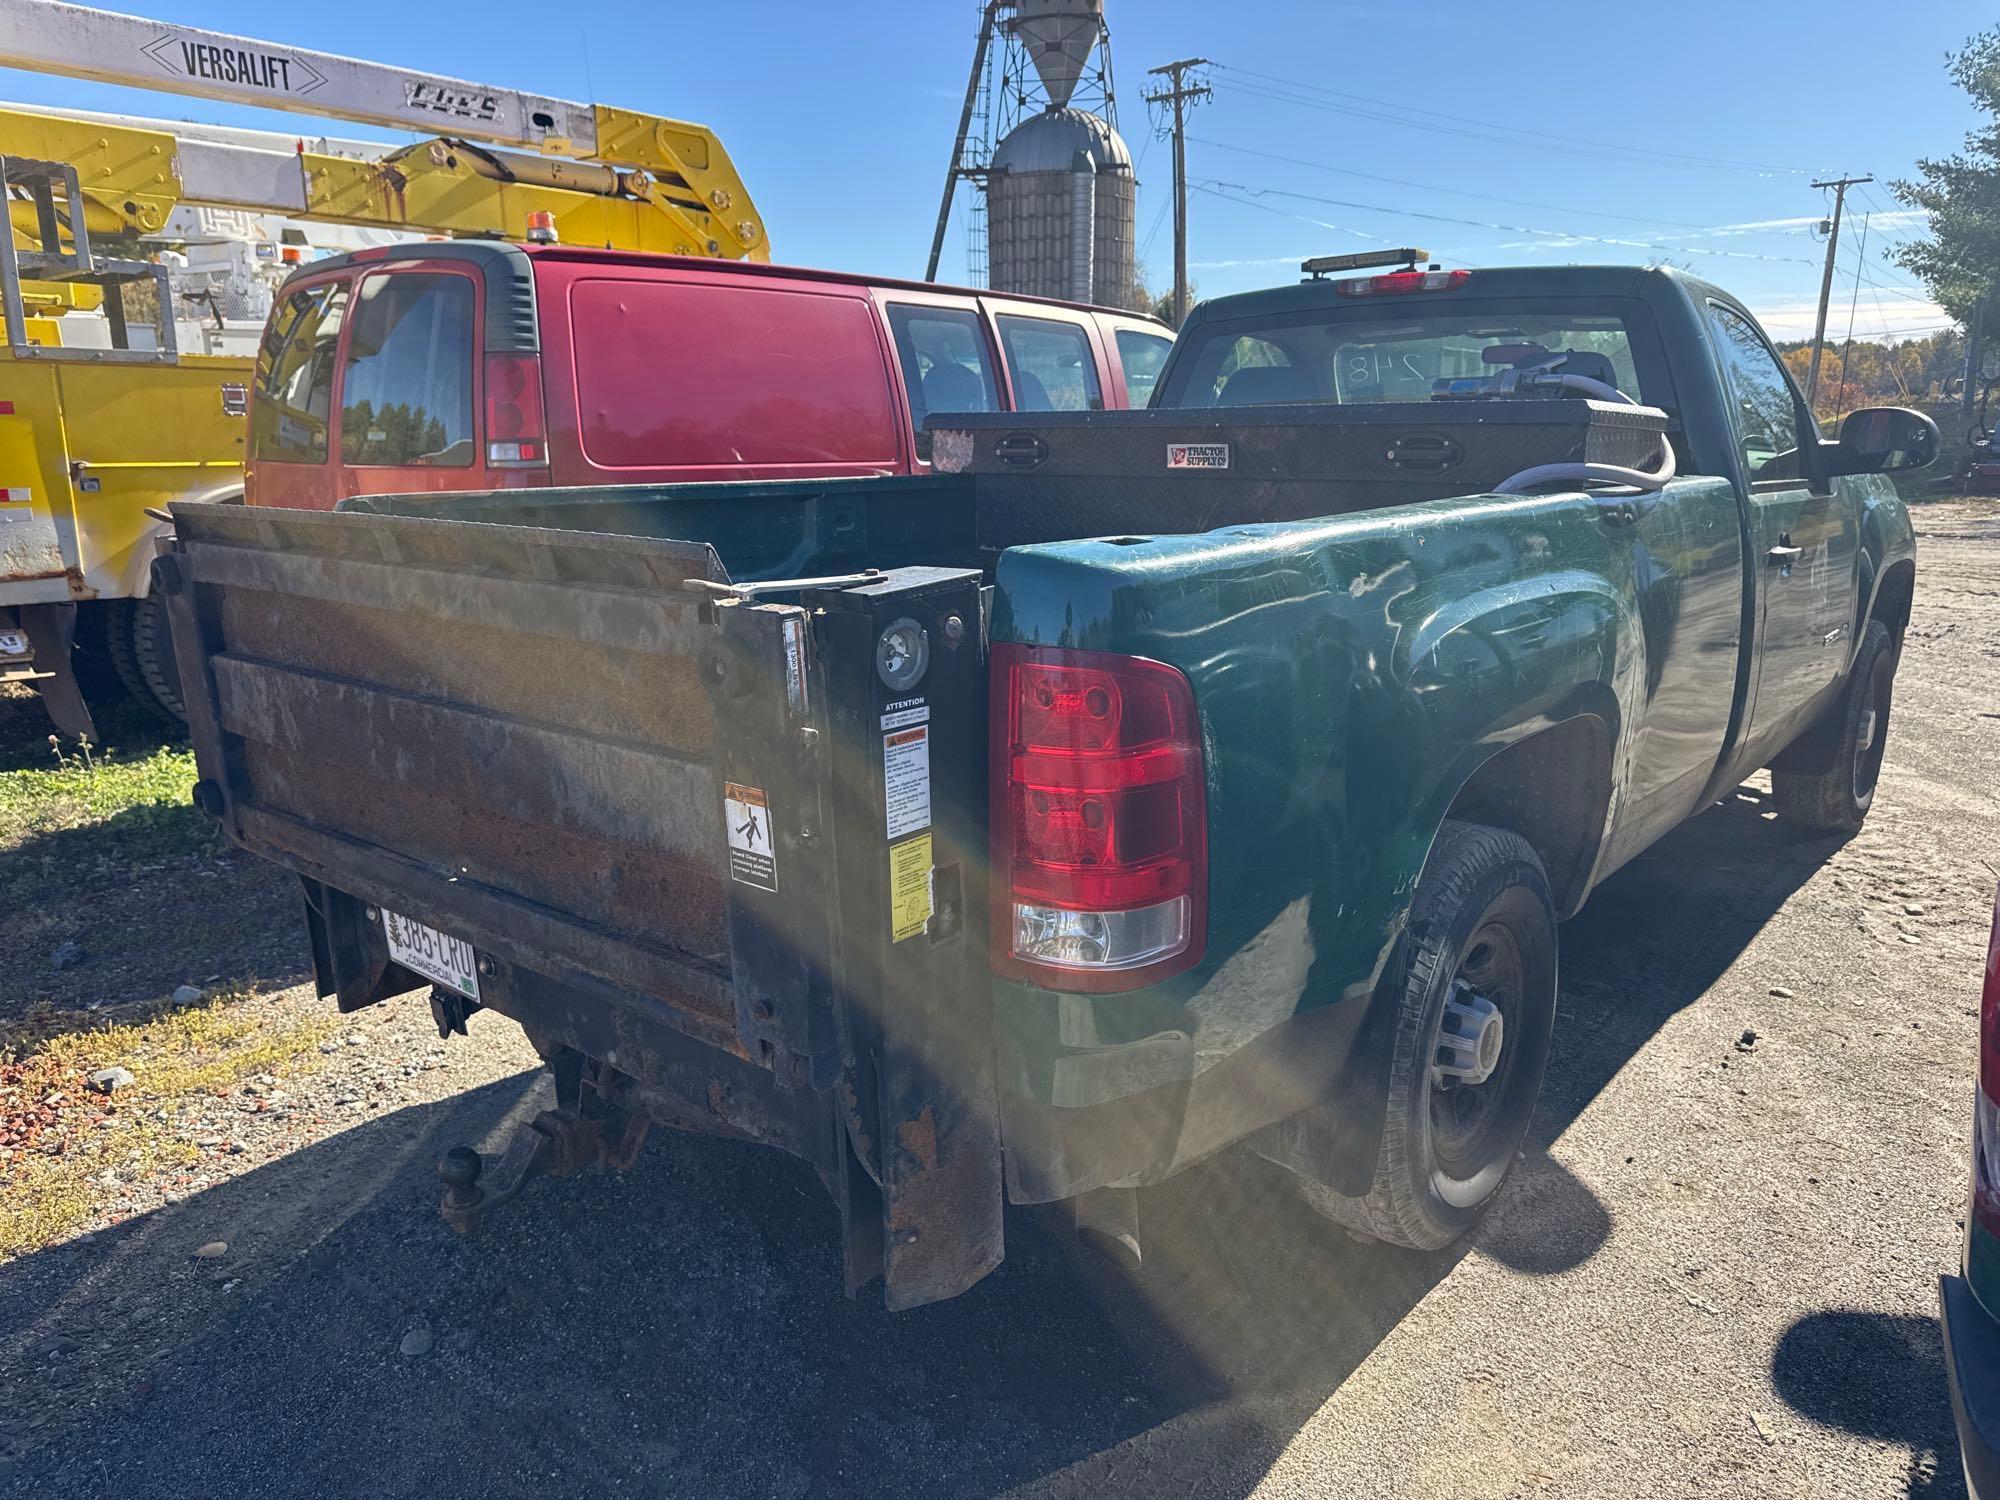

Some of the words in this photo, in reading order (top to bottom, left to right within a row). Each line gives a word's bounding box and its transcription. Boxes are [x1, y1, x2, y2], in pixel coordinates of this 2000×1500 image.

[181, 41, 290, 91] VERSALIFT
[1187, 447, 1226, 456] TRACTOR
[1187, 457, 1217, 466] SUPPLY
[885, 697, 925, 711] ATTENTION
[896, 728, 925, 742] WARNING
[733, 865, 750, 873] storage
[753, 864, 772, 873] platform
[408, 954, 456, 985] COMMERCIAL
